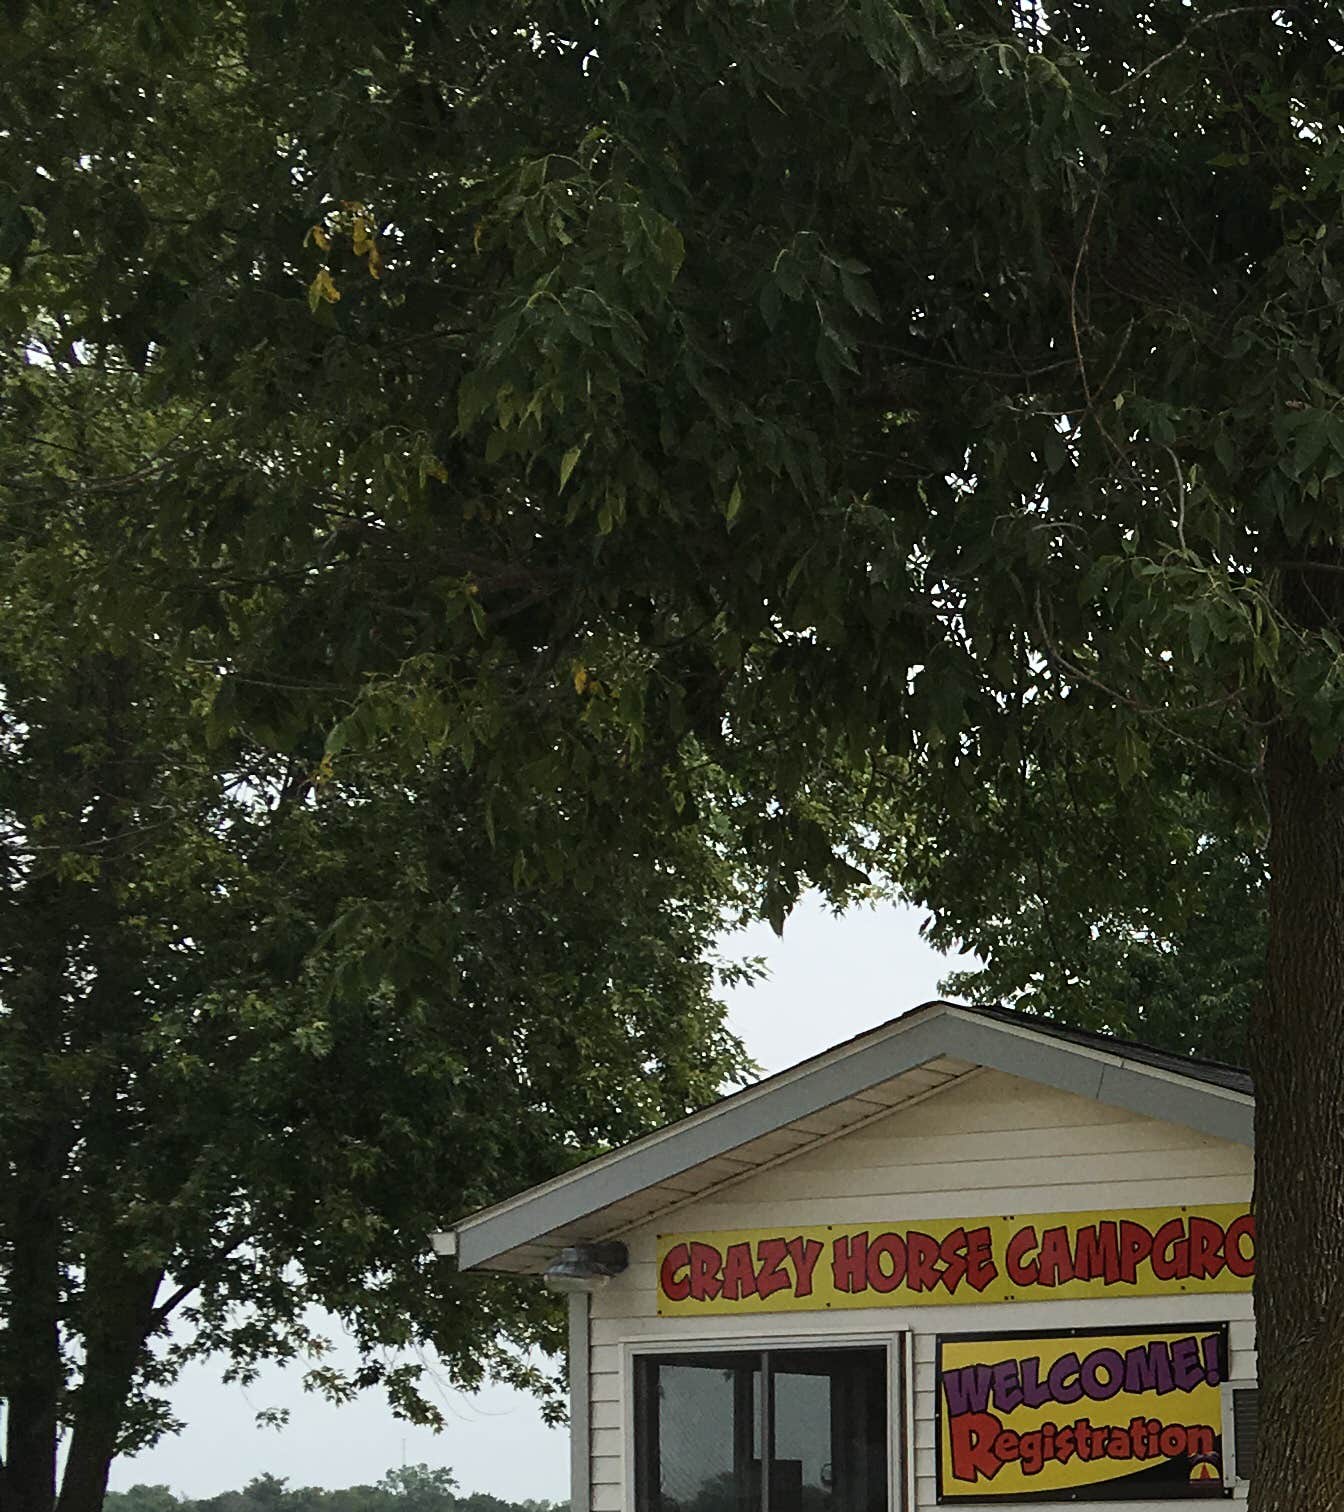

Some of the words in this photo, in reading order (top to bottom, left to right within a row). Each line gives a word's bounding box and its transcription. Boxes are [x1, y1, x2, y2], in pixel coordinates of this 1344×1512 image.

[660, 1236, 824, 1301] CRAZY
[831, 1228, 998, 1295] HORSE
[943, 1334, 1220, 1416] WELCOME!
[950, 1411, 1215, 1483] Registration
